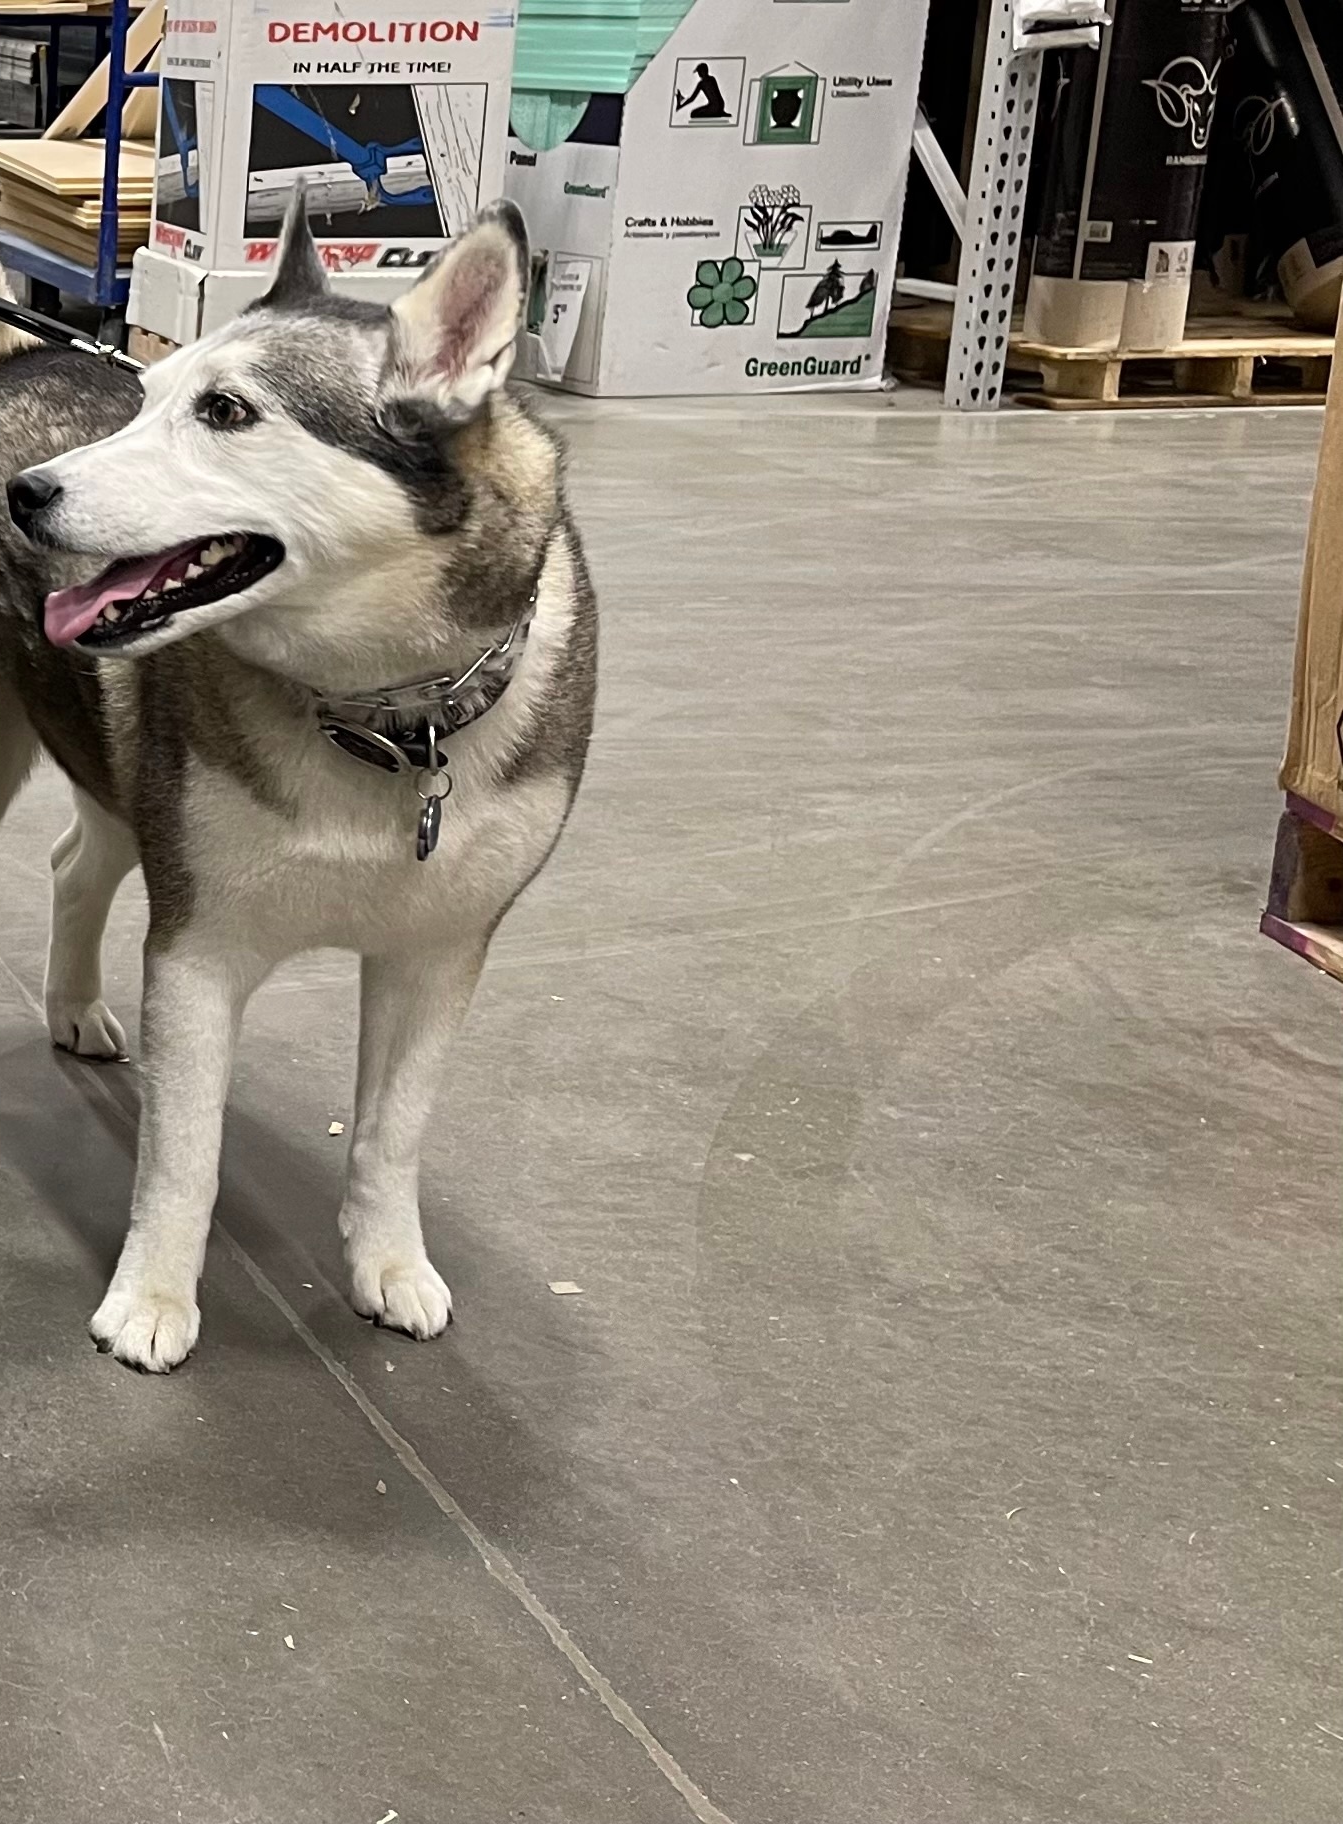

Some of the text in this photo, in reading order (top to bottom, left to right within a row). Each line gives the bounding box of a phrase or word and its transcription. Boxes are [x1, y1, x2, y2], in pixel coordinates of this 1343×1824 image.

[268, 21, 480, 43] DEMOLITION
[293, 61, 452, 73] IN HALF THE TIME!
[833, 76, 864, 89] Utility
[625, 216, 657, 227] Crafts
[671, 216, 714, 227] Hobbies
[745, 355, 862, 377] GreenGuard
